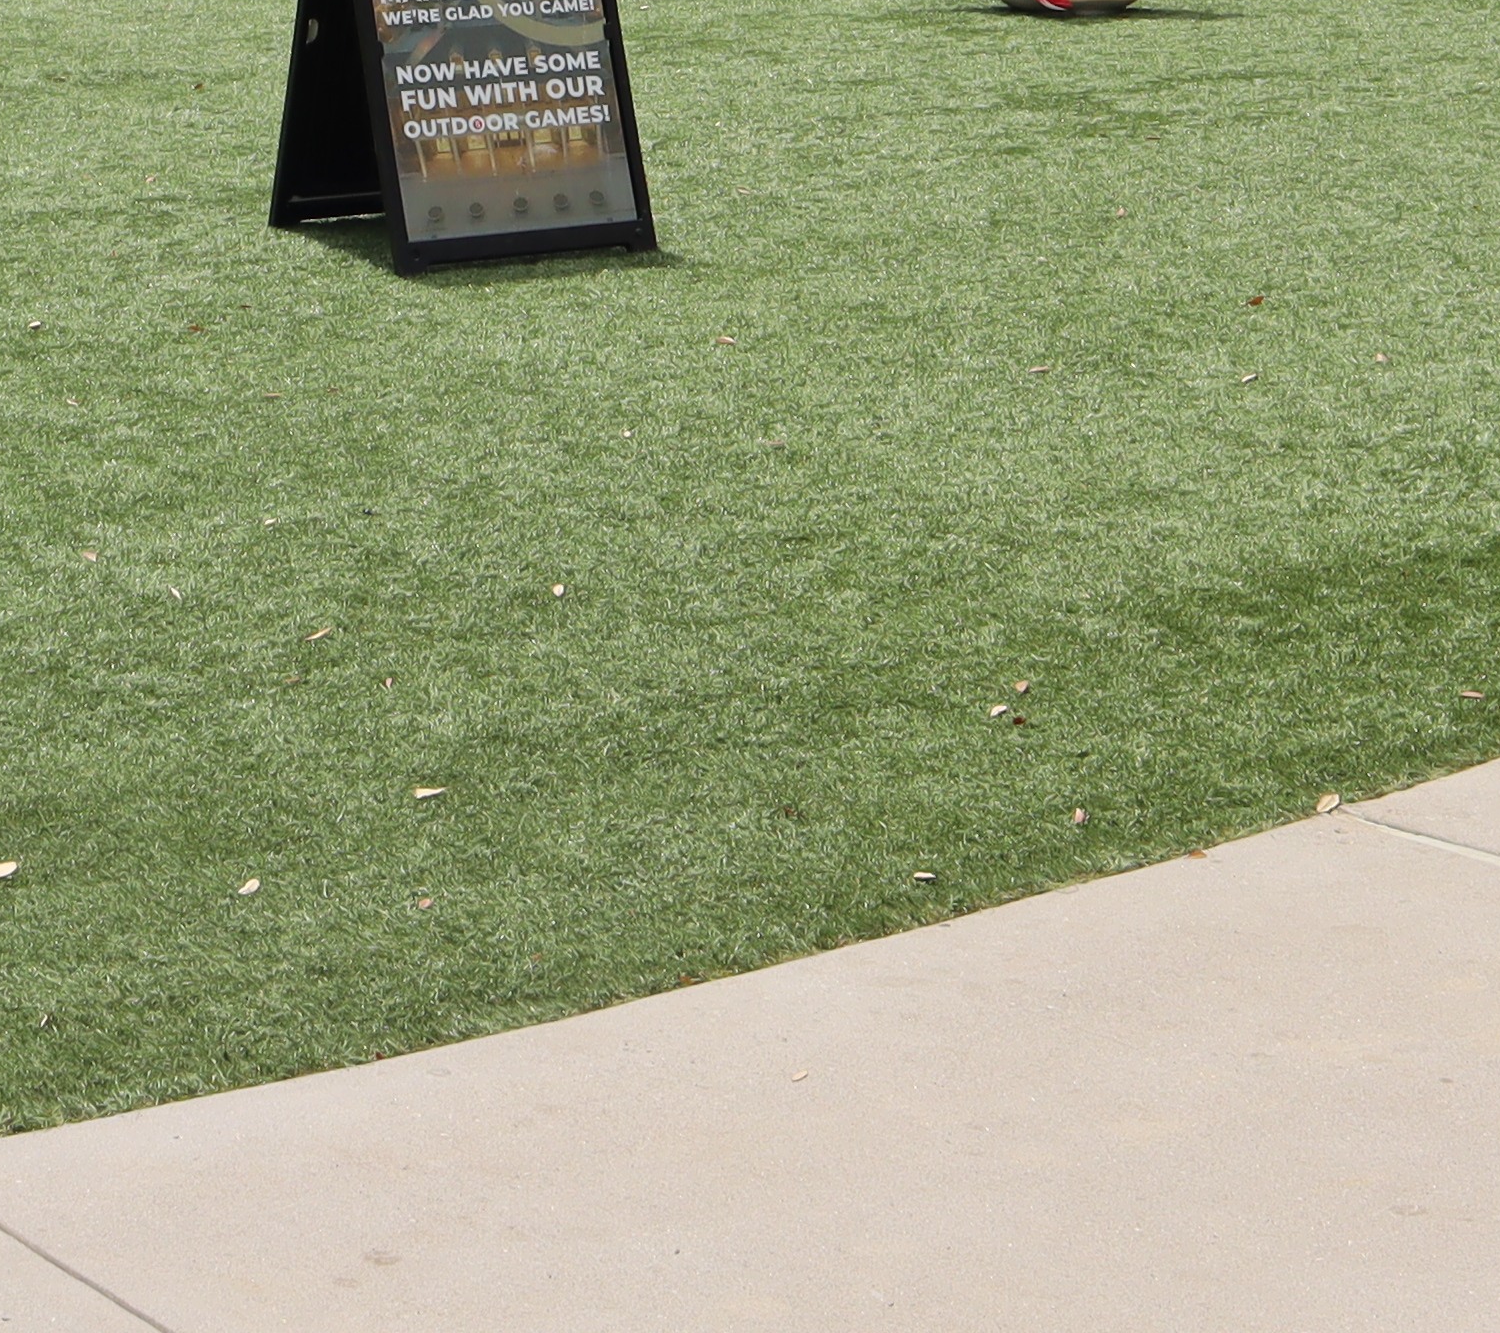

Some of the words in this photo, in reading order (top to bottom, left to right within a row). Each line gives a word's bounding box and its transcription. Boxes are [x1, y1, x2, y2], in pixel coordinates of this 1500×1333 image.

[382, 8, 441, 26] WE'RE
[445, 5, 494, 21] GLAD
[497, 1, 535, 17] YOU
[395, 62, 456, 85] NOW
[463, 56, 529, 80] HAVE
[533, 50, 602, 74] SOME
[400, 86, 458, 112] FUN
[464, 81, 539, 106] WITH
[546, 75, 606, 100] OUR
[403, 113, 520, 139] OUTDOOR
[524, 104, 611, 129] GAMES!
